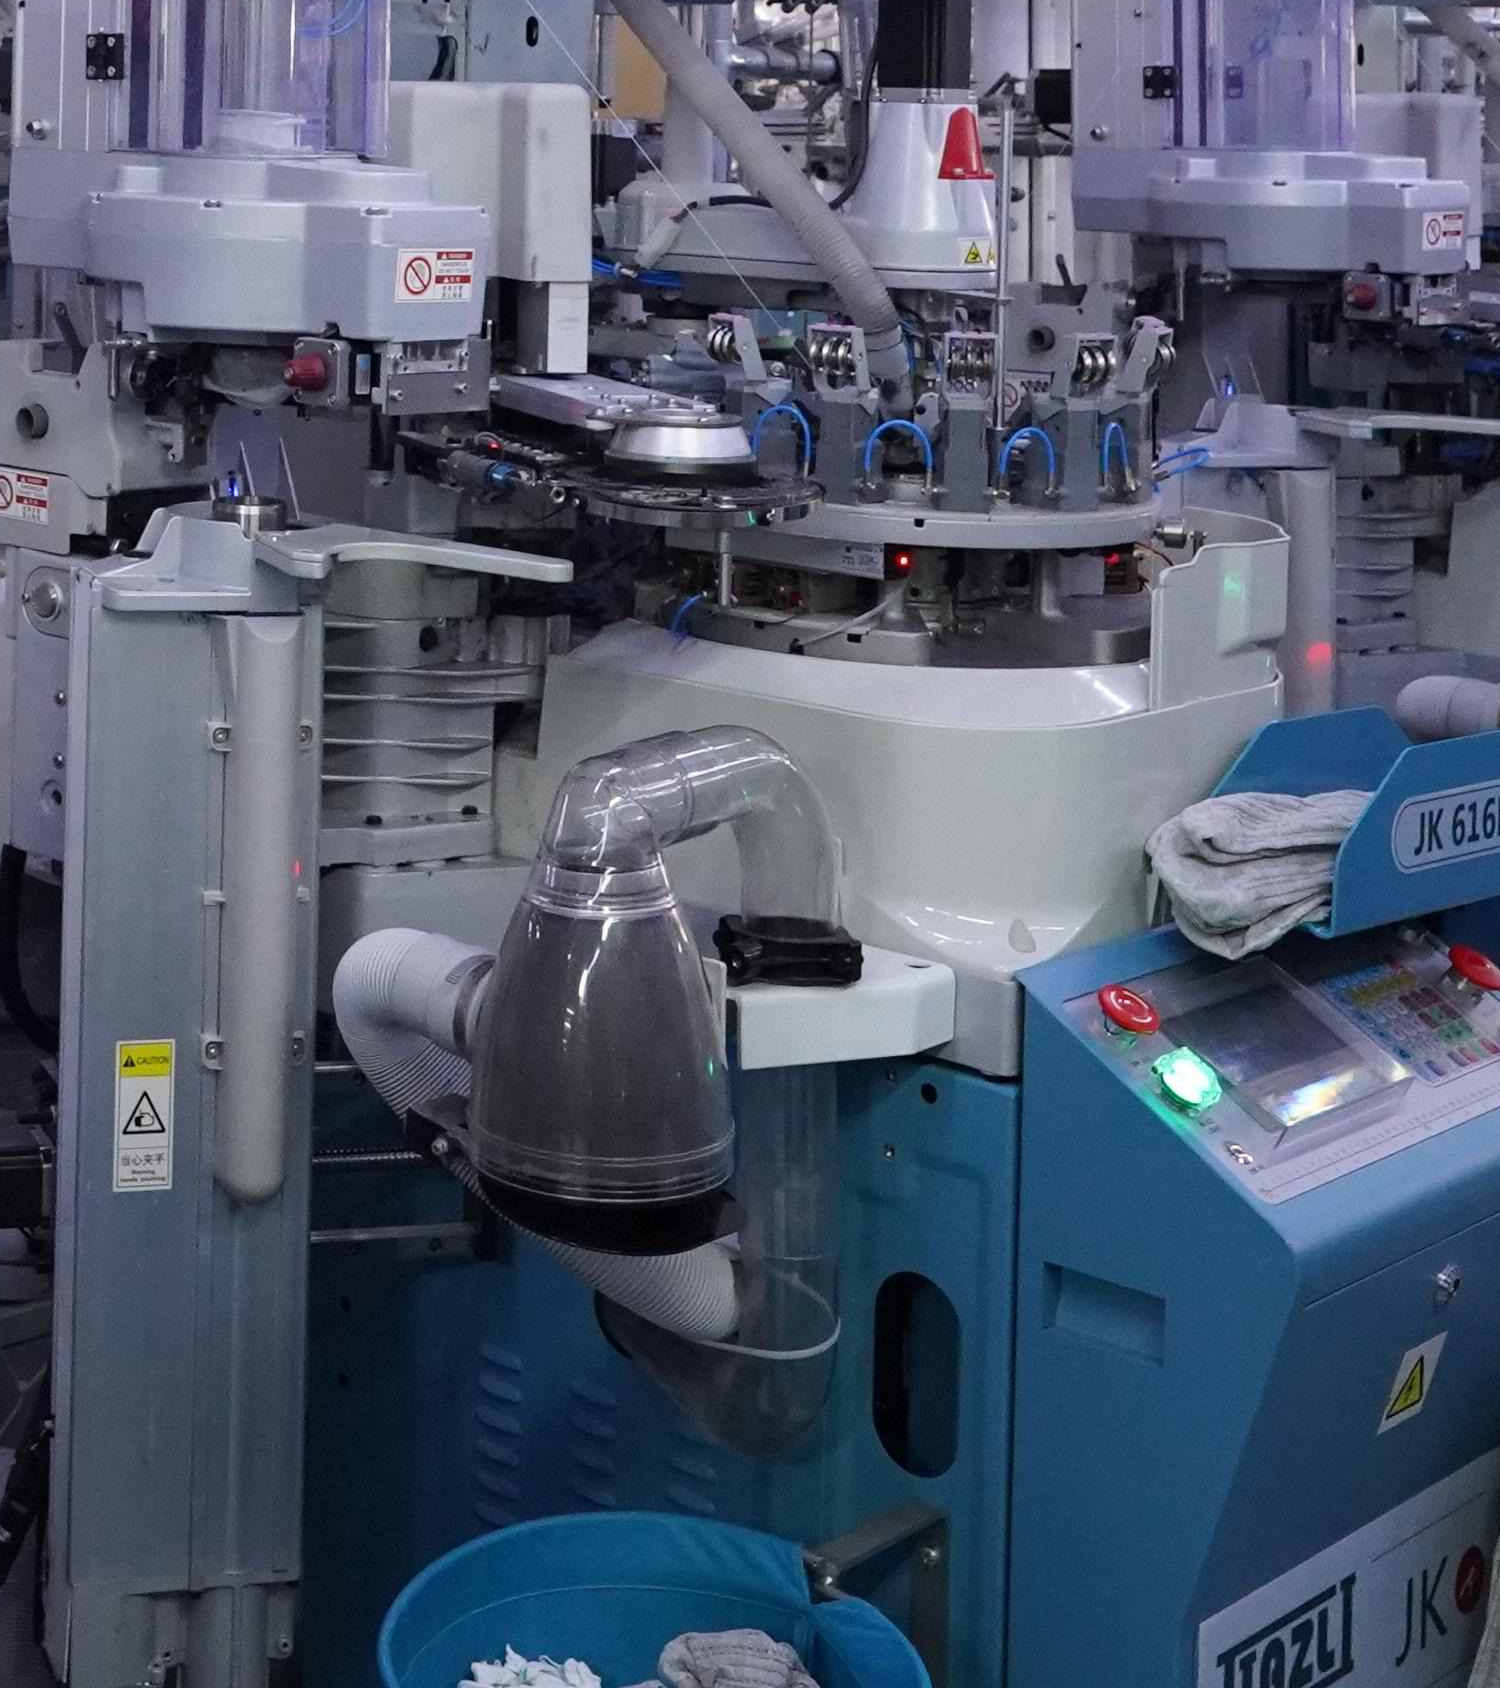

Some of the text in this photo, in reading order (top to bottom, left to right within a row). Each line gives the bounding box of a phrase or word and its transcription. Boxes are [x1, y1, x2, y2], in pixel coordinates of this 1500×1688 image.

[1414, 808, 1443, 856] JK
[137, 1055, 170, 1065] CAUTION
[1395, 1556, 1448, 1667] JK
